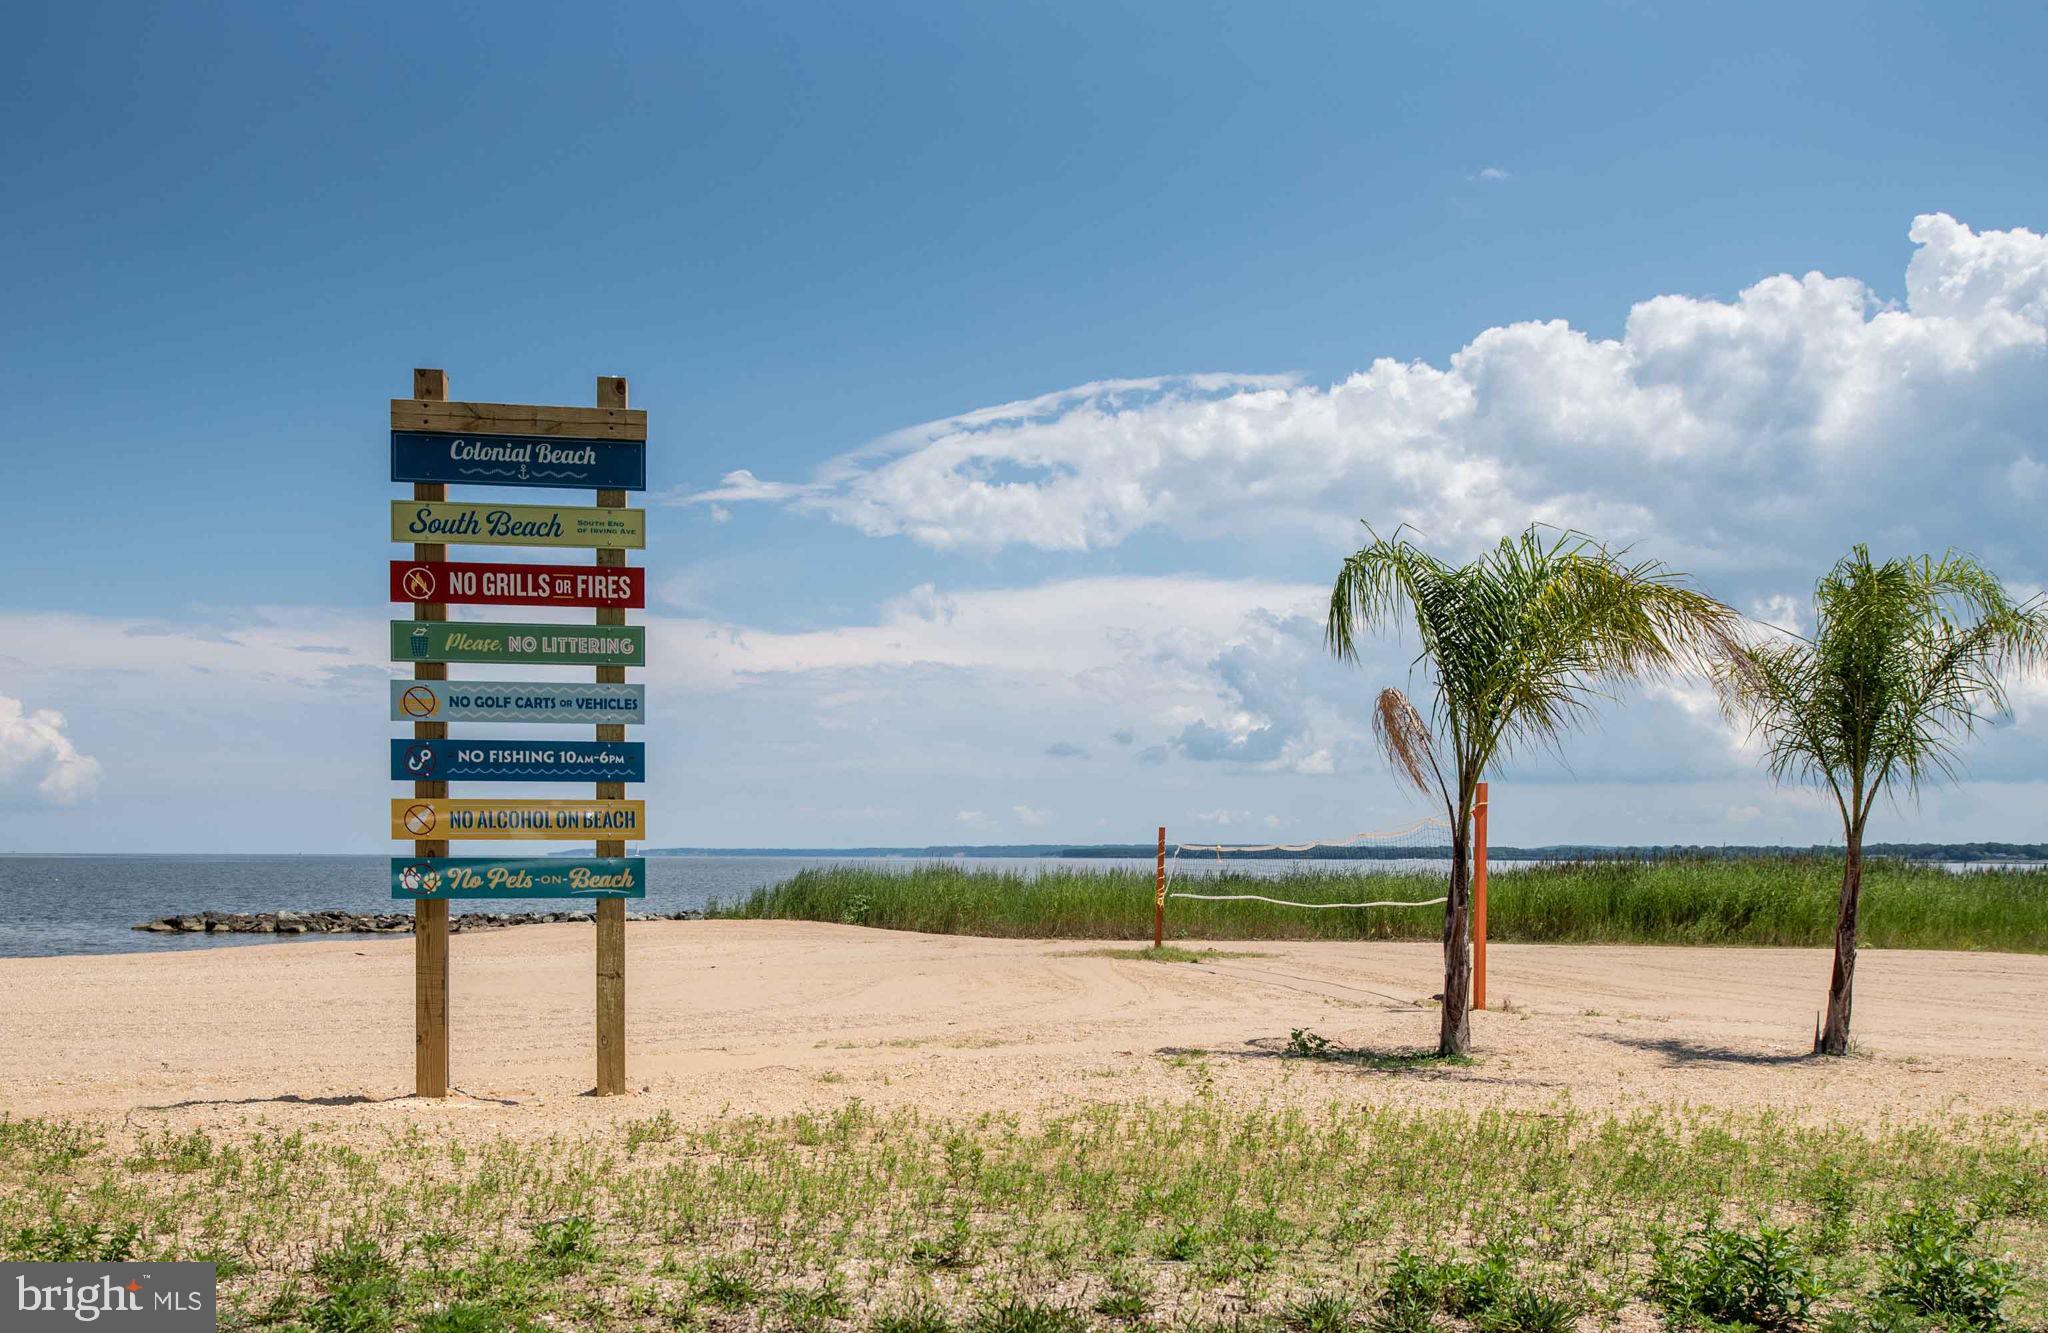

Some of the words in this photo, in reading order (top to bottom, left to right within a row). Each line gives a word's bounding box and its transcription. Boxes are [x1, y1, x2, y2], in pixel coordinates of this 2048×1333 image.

[450, 439, 531, 463] Colonial
[536, 443, 597, 465] Beach
[409, 508, 482, 536] South
[485, 510, 564, 538] Beach
[450, 571, 477, 596] NO
[482, 572, 550, 597] GRILLS
[555, 579, 572, 594] OR
[577, 575, 631, 599] FIRES
[508, 636, 537, 653] NO
[542, 636, 634, 655] LITTERING
[449, 696, 471, 708] NO
[476, 696, 512, 709] GOLF
[515, 697, 556, 710] CARTS
[559, 699, 573, 708] OR
[575, 698, 638, 710] VEHICLES
[458, 750, 484, 763] NO
[489, 750, 555, 764] FISHING
[450, 810, 474, 829] NO
[477, 810, 553, 829] ALCOHOL
[556, 810, 579, 829] ON
[583, 810, 636, 829] BEACH
[448, 867, 483, 890] No
[487, 867, 533, 890] Pets
[568, 867, 635, 890] Beach
